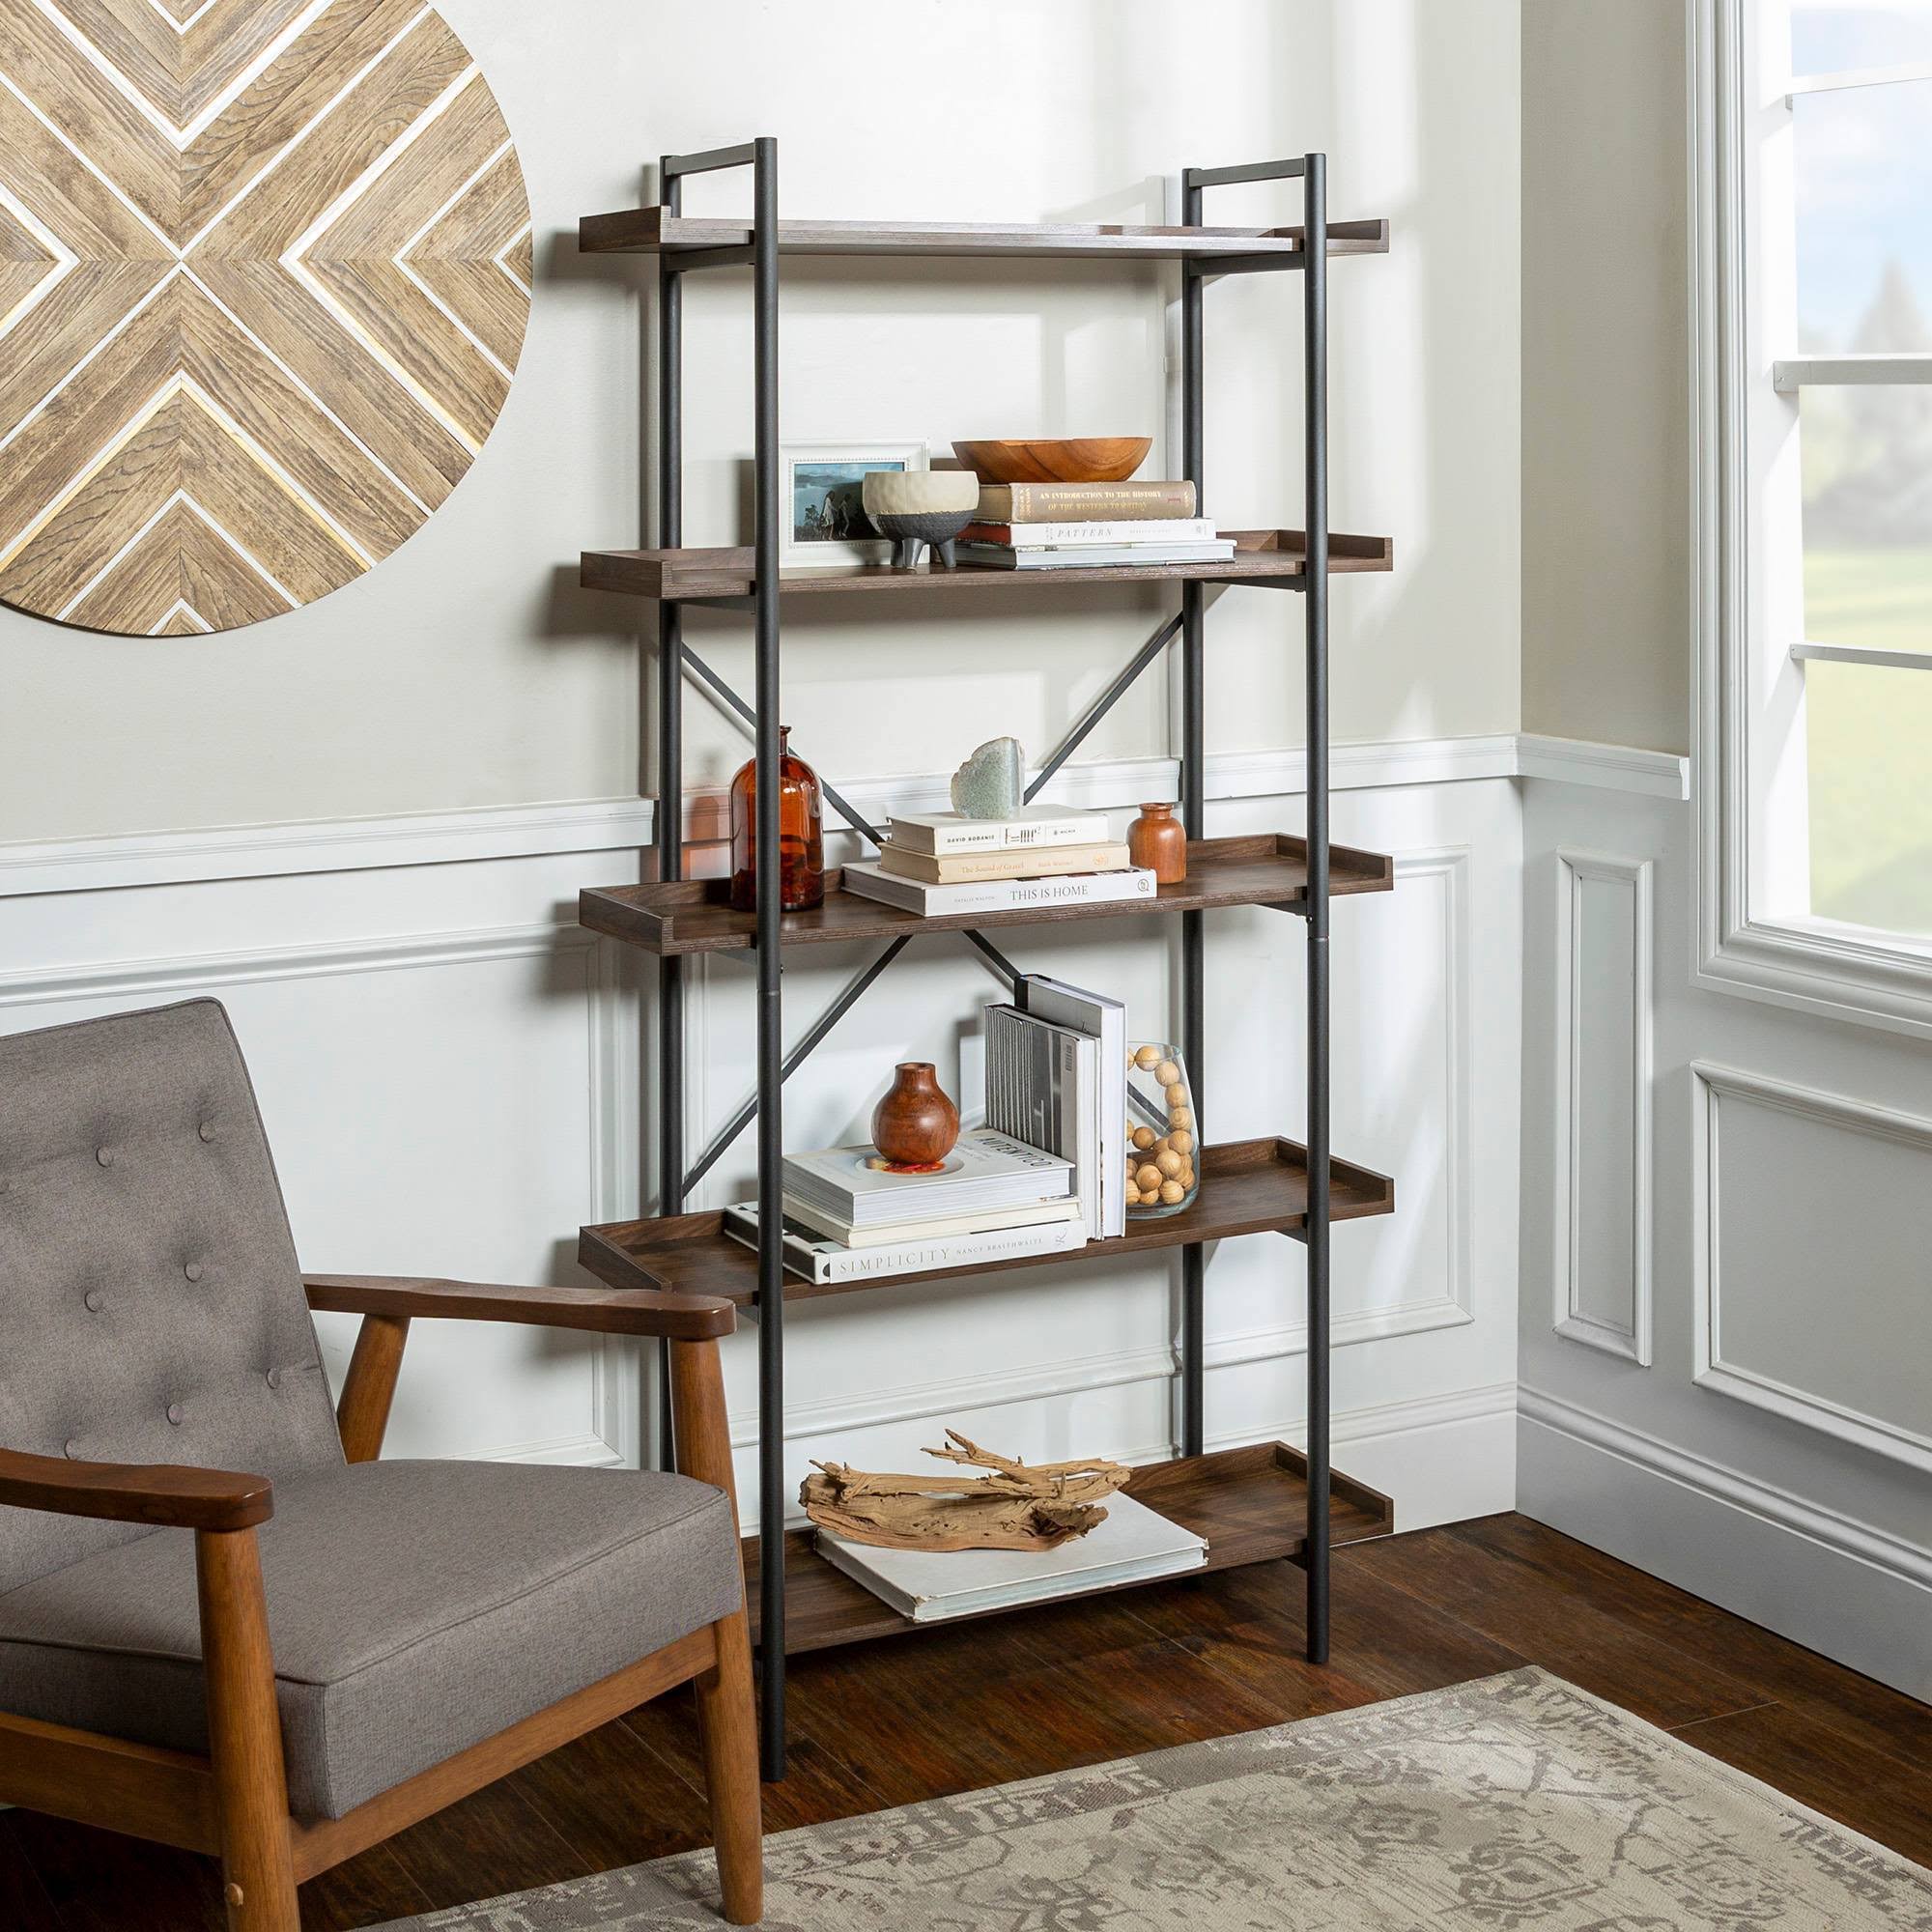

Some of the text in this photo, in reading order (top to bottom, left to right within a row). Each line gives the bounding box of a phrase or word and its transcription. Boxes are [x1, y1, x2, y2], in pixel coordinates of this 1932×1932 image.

[1104, 491, 1114, 499] TO
[1116, 491, 1130, 499] THE
[1132, 490, 1162, 498] HISTORY
[1057, 527, 1113, 538] PATTERN
[960, 865, 974, 874] The
[975, 864, 996, 873] Sound
[1010, 883, 1089, 901] THIS IS HOME
[974, 1137, 1053, 1167] AUTENTICO
[956, 1238, 1043, 1255] NANCY BRAITHWAITE
[839, 1249, 950, 1274] SIMPLICITY
